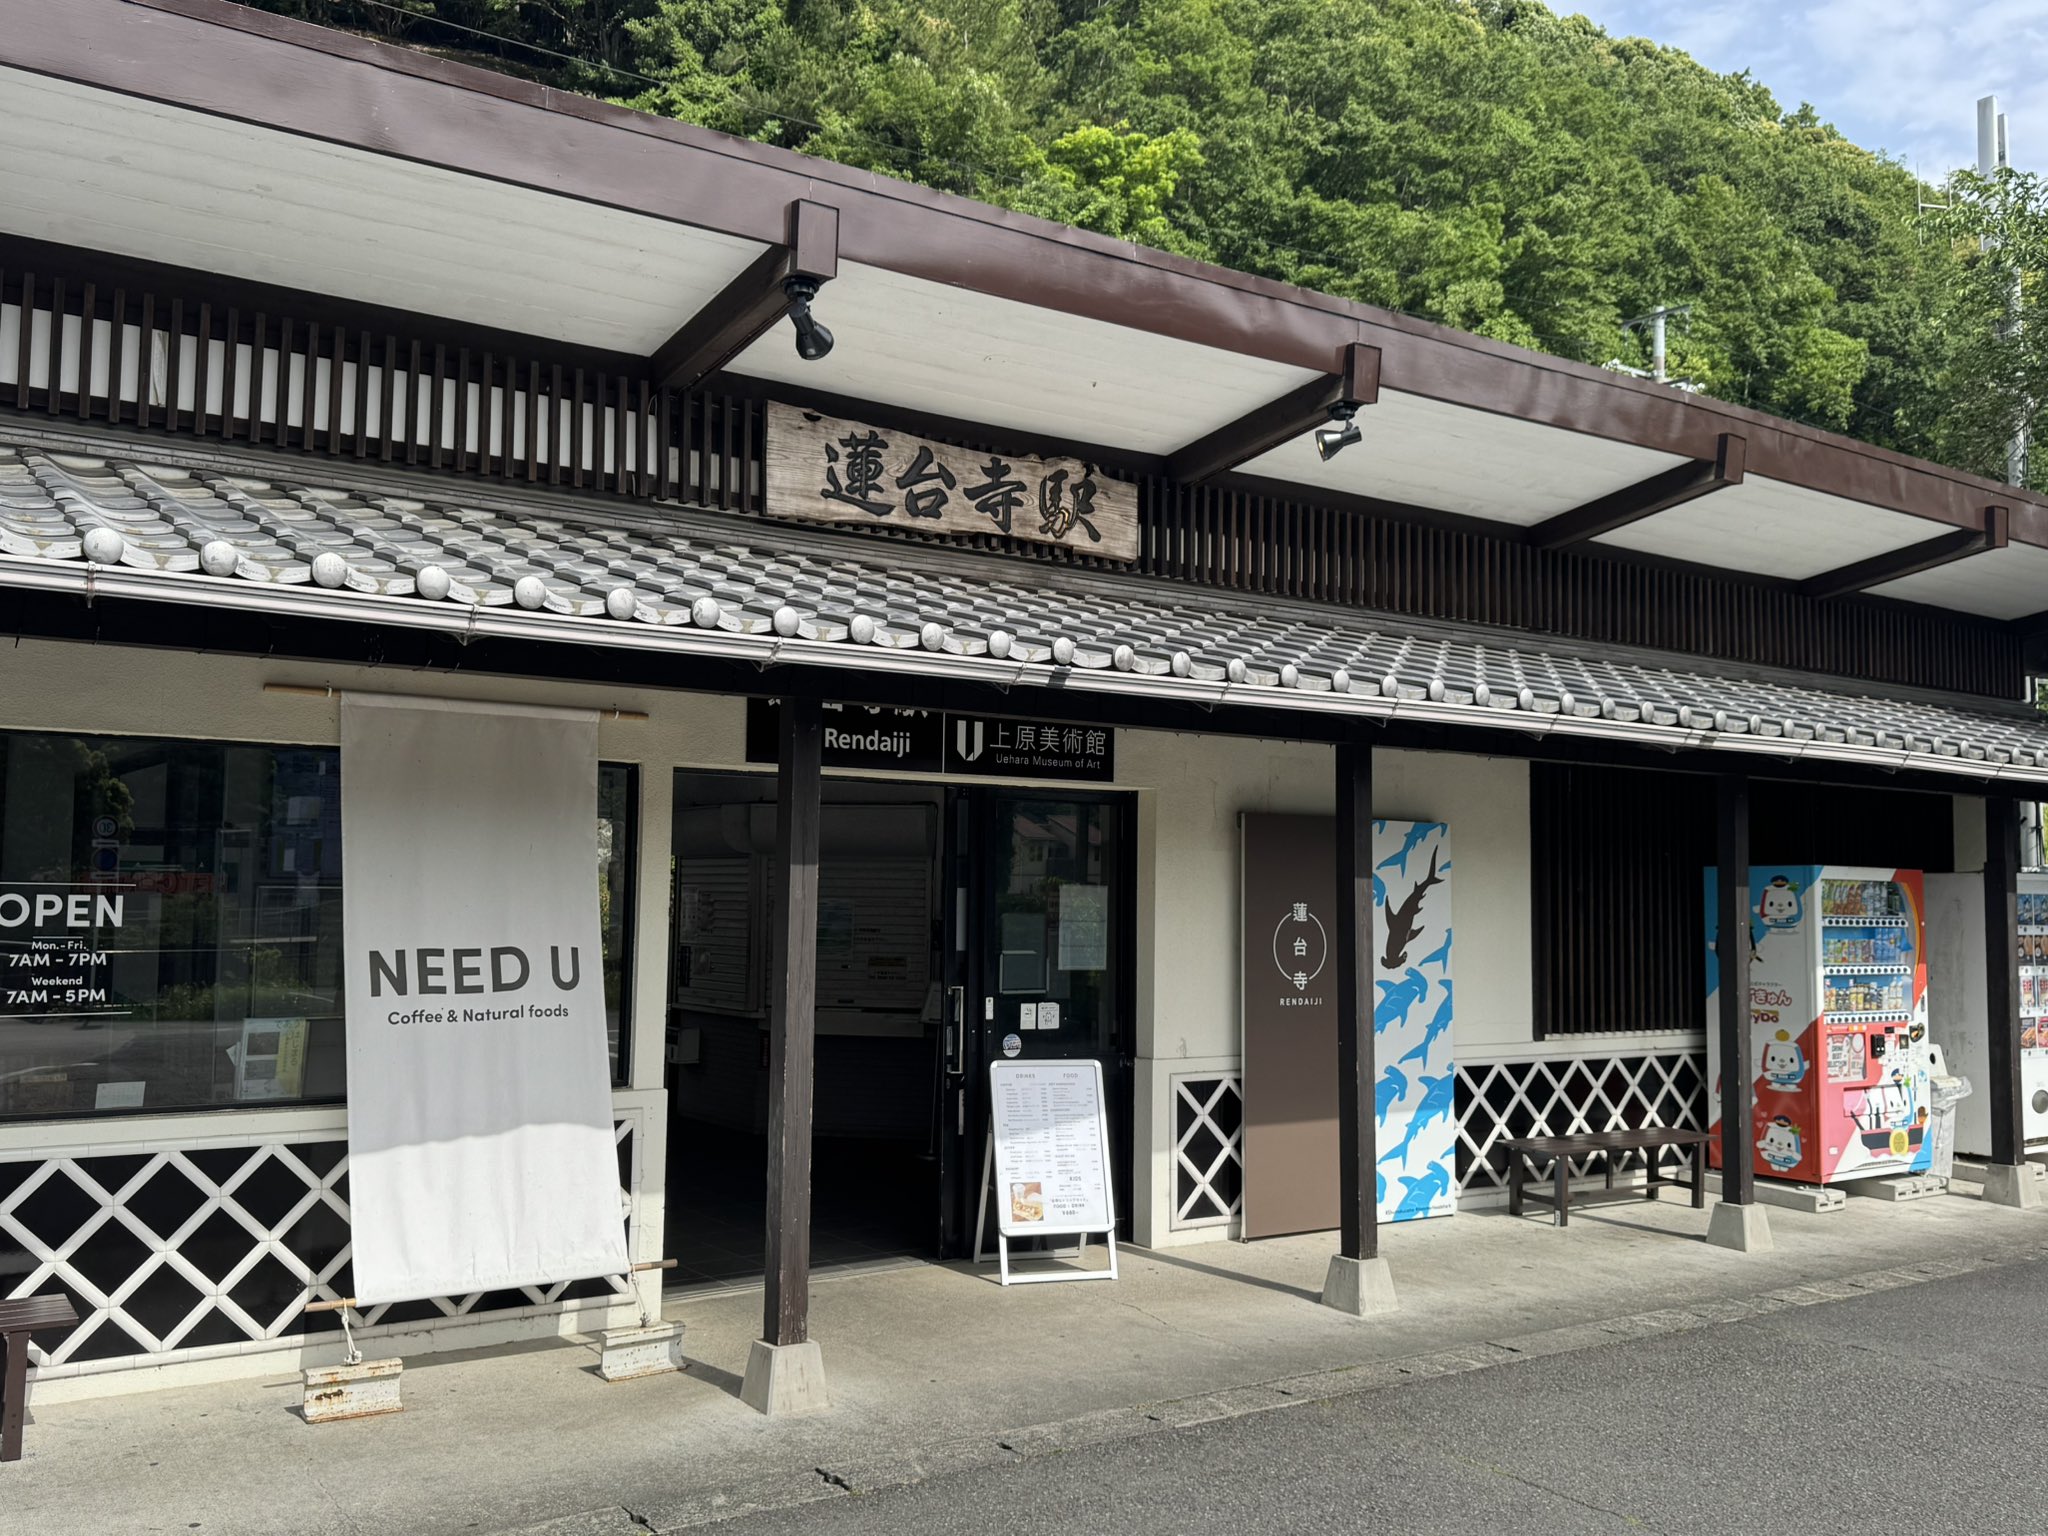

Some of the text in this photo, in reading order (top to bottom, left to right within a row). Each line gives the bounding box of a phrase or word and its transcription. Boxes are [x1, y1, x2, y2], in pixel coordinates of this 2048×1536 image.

[824, 727, 911, 758] Rendaiji
[990, 722, 1106, 756] 上原美術館
[996, 753, 1101, 770] Uehara Museum of Art
[0, 893, 124, 928] OPEN
[1293, 902, 1308, 990] 蓮台寺
[9, 953, 50, 967] 7AM
[68, 952, 107, 967] 7PM
[31, 976, 83, 986] Weekend
[369, 945, 580, 998] NEED U
[7, 989, 48, 1004] 7AM
[65, 988, 106, 1002] 5PM
[1280, 998, 1322, 1006] RENDAIJI
[388, 1004, 569, 1025] Coffee & Natural foods
